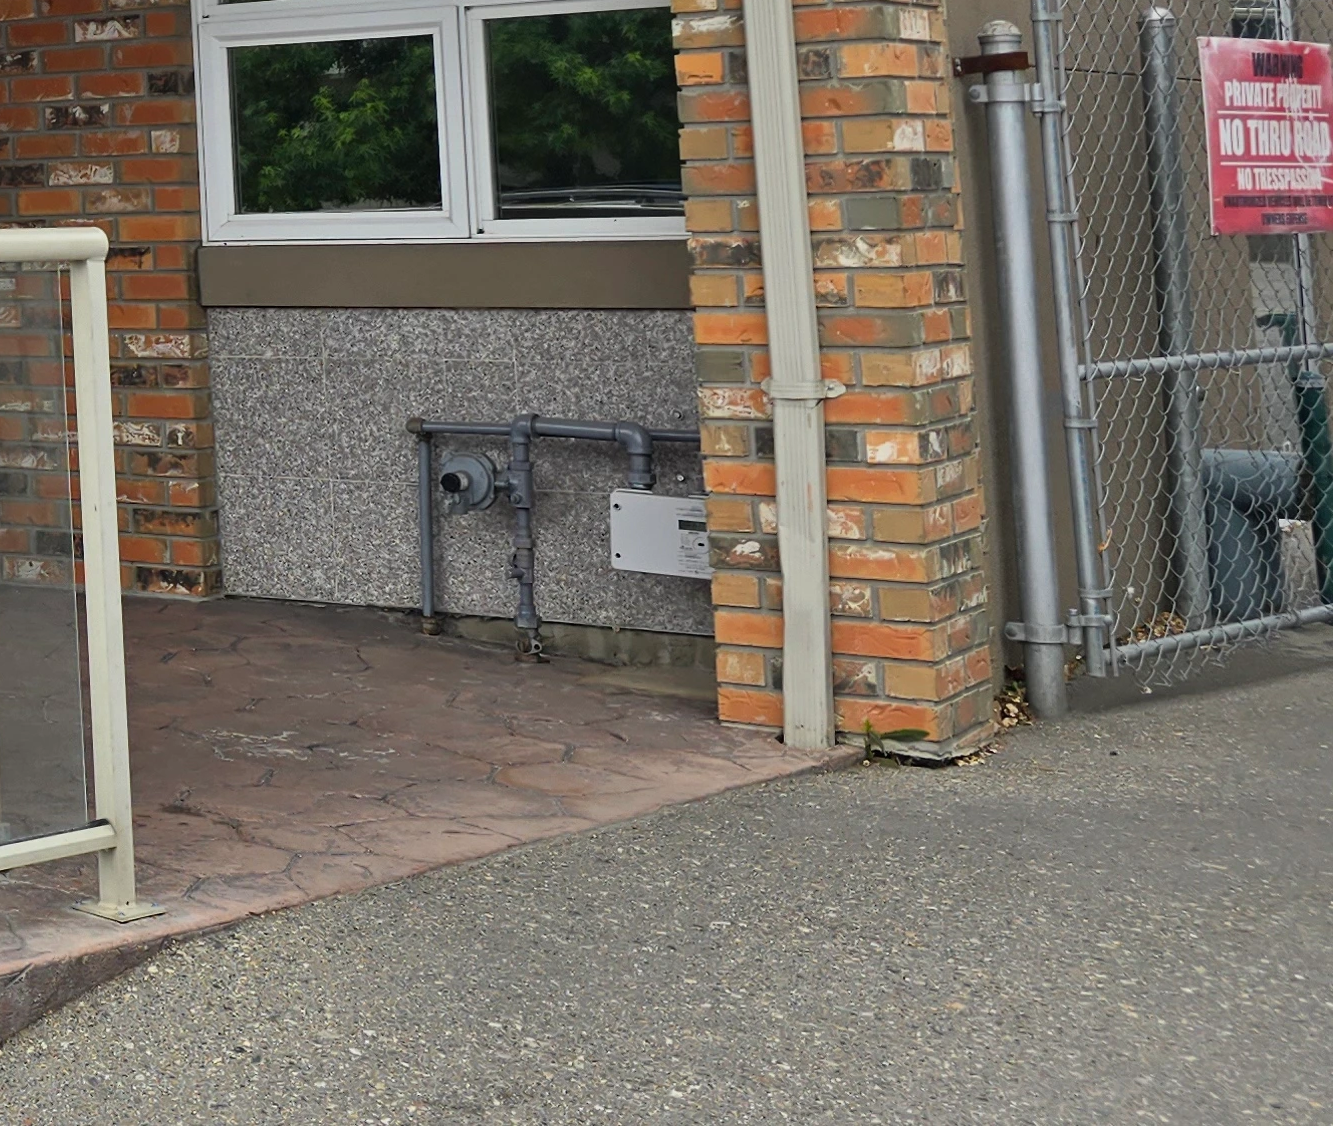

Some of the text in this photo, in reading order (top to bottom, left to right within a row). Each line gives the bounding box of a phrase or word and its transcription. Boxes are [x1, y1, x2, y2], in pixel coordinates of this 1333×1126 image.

[1224, 80, 1275, 107] PRIVATE
[1218, 118, 1331, 157] NO THRU ROAD
[1237, 167, 1253, 190] NO
